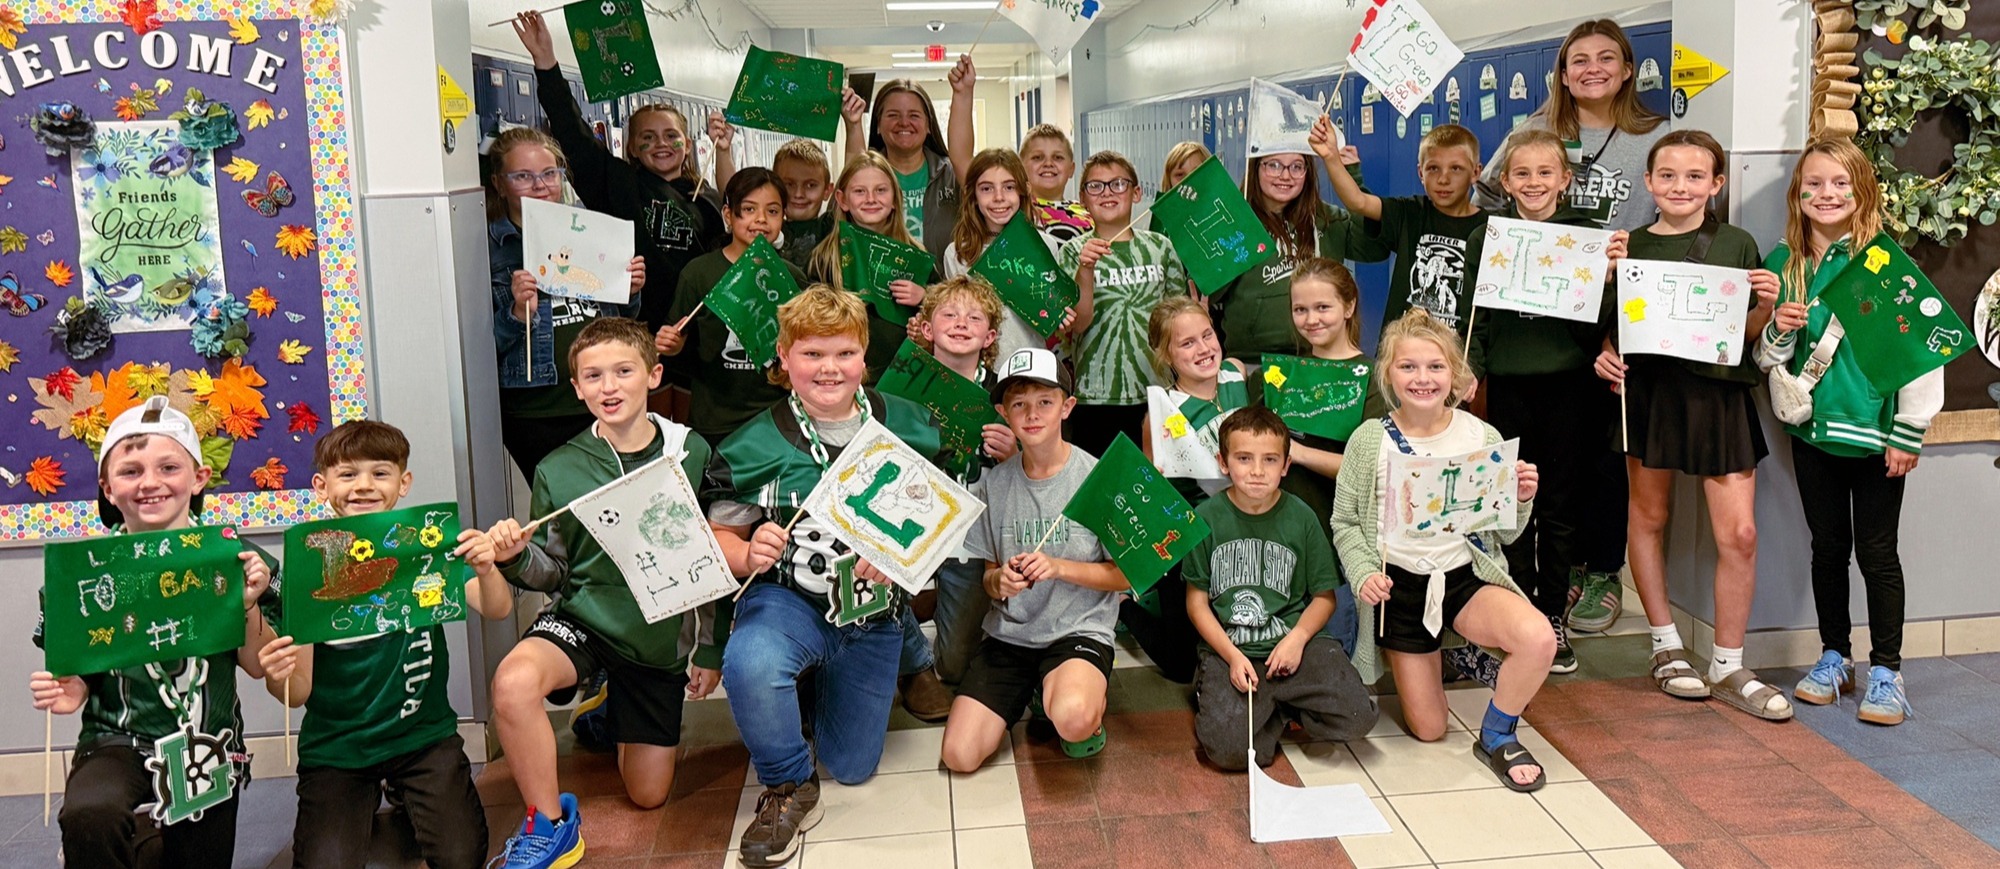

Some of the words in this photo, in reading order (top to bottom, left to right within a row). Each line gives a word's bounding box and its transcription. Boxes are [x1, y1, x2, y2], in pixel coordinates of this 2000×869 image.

[1398, 43, 1432, 88] Green
[1674, 50, 1682, 60] F3
[118, 191, 177, 204] Friends
[1568, 175, 1632, 202] KERS
[91, 207, 211, 263] Gather
[138, 255, 171, 266] HERE
[1262, 257, 1295, 283] Sparta
[1094, 264, 1166, 288] LAKERS
[553, 315, 584, 328] HEER
[844, 460, 925, 549] L
[1441, 467, 1484, 515] L
[1113, 493, 1148, 540] Green
[1013, 519, 1071, 546] LAKERS
